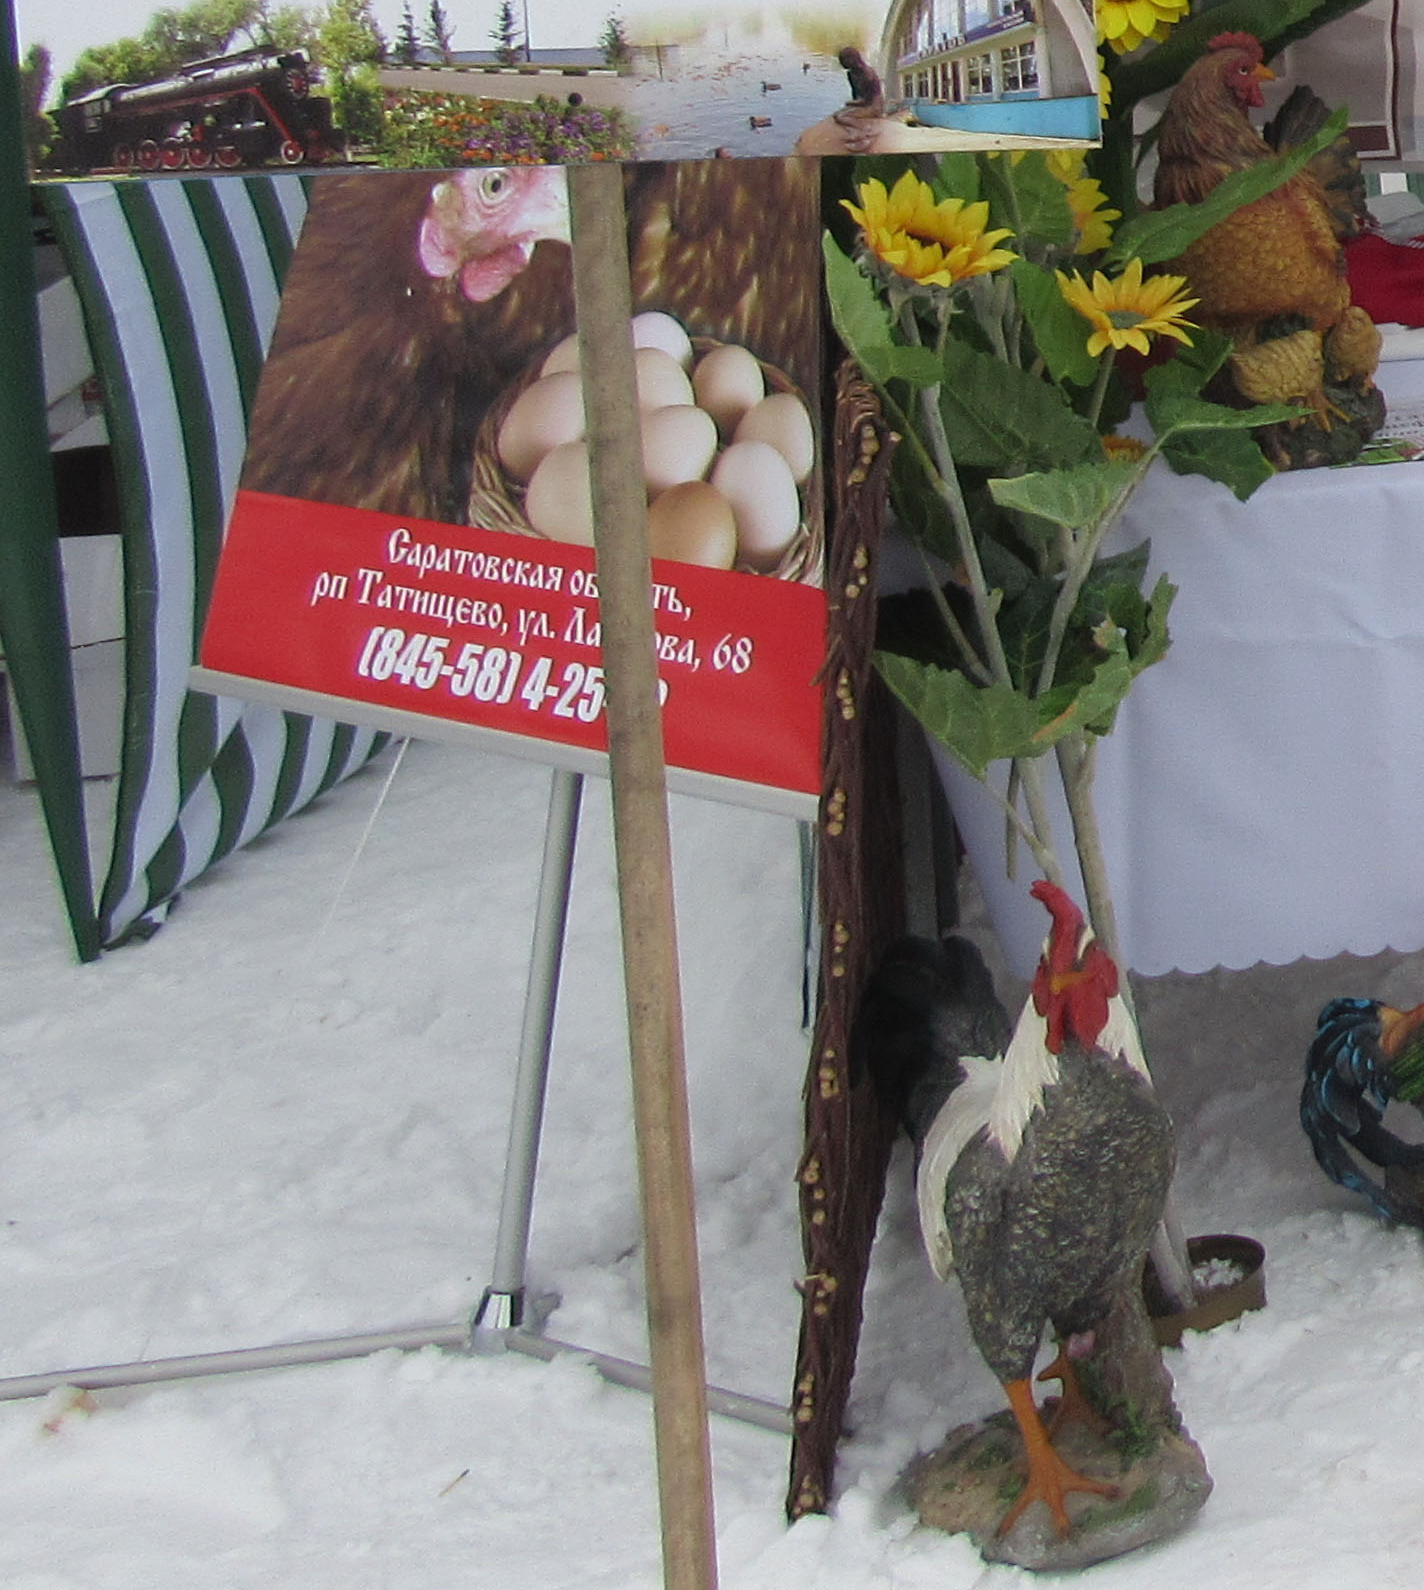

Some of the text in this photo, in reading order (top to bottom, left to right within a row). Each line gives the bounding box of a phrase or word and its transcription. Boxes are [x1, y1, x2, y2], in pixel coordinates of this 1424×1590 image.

[389, 528, 692, 621] Саратовская обть,
[311, 572, 347, 606] рп
[357, 569, 508, 636] Татищево,
[519, 609, 555, 645] ул.
[712, 633, 753, 674] 68
[358, 626, 522, 704] (845-58)
